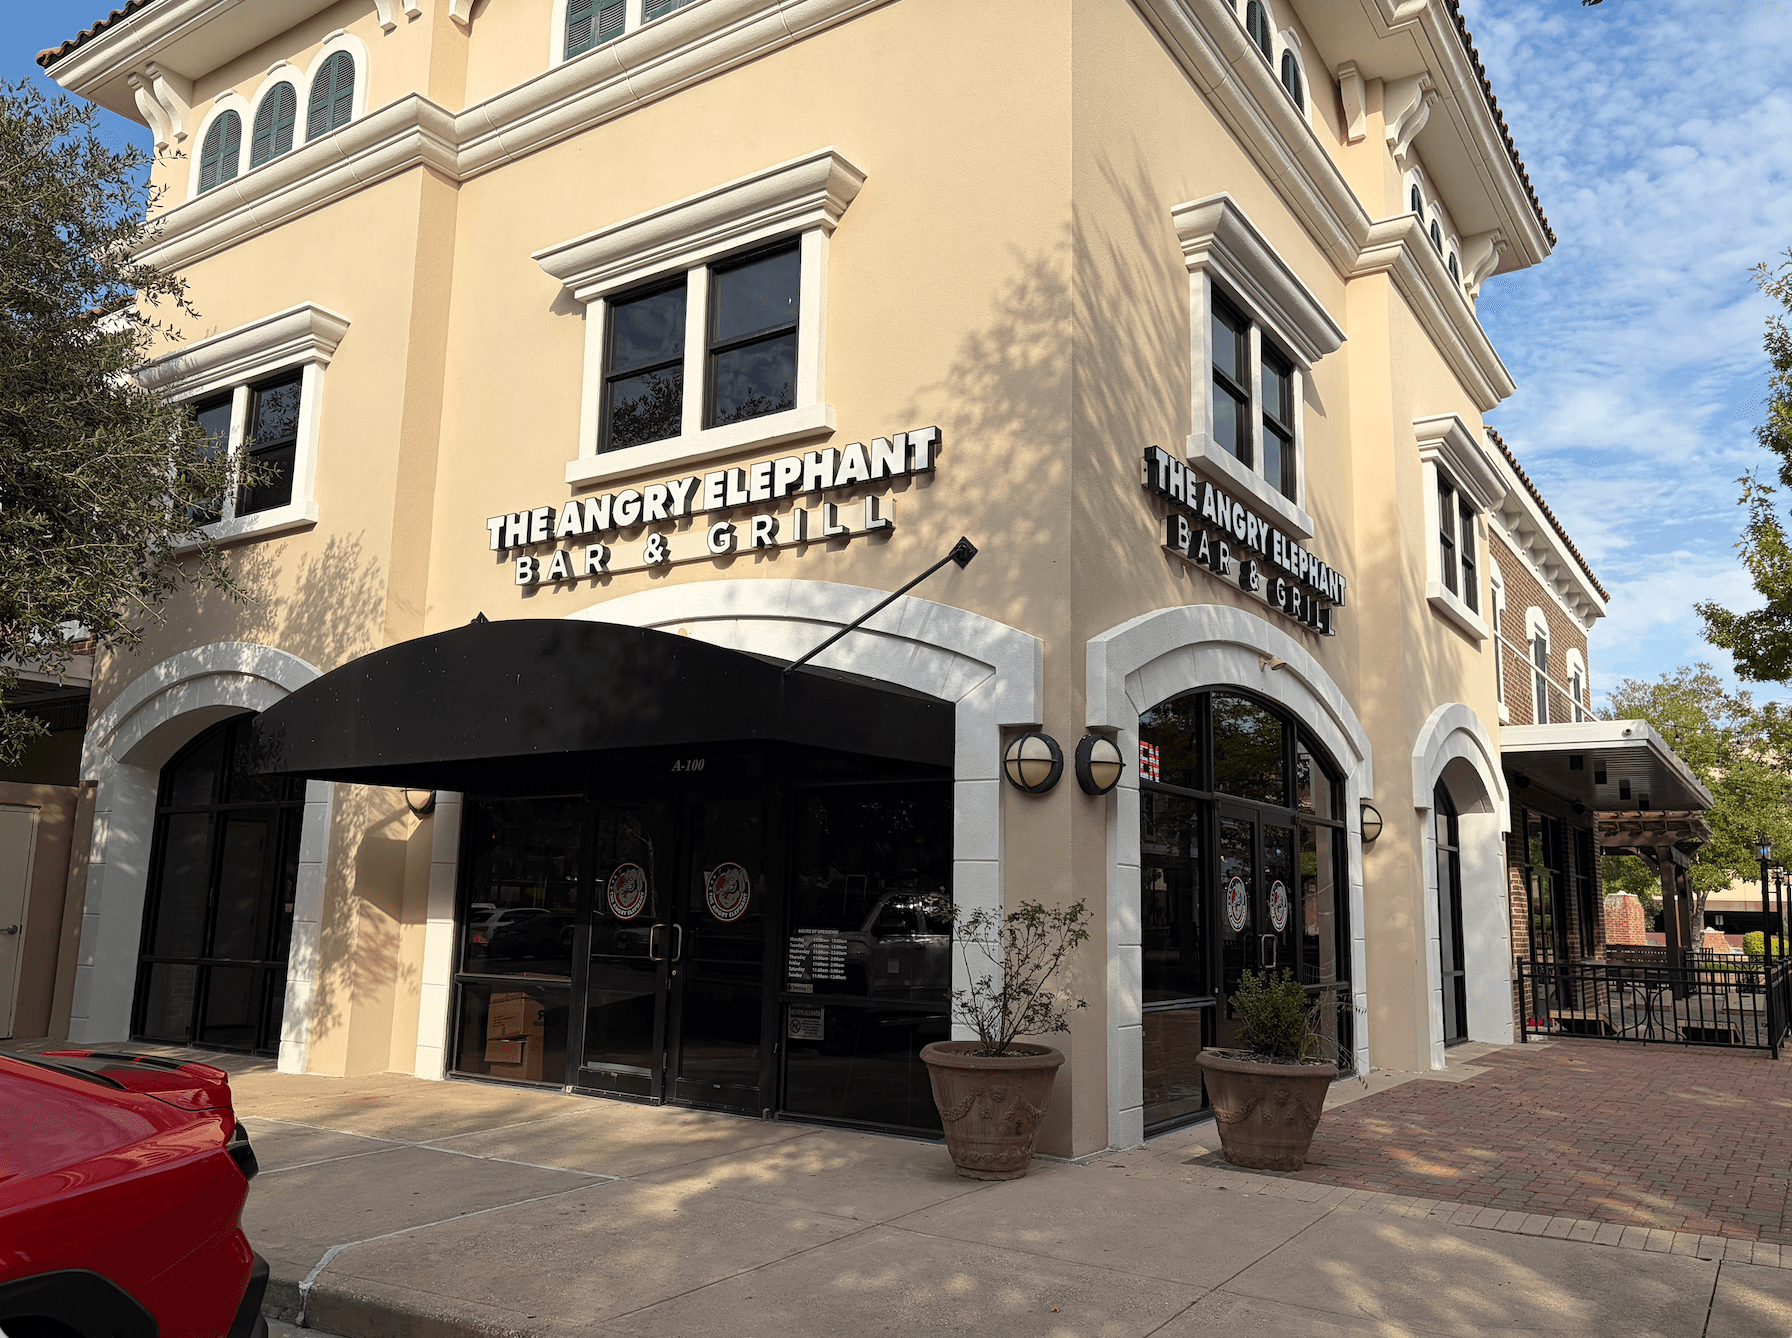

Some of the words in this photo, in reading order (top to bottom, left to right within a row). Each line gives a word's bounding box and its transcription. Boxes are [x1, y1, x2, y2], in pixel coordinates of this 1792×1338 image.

[487, 507, 556, 550] THE
[556, 476, 702, 539] ANGRY
[703, 426, 941, 511] ELEPHANT
[1151, 446, 1198, 511] THE
[1201, 481, 1269, 556] ANGRY
[1272, 527, 1346, 607] ELEPHANT
[515, 543, 612, 586] BAR
[643, 533, 671, 567] &
[707, 495, 893, 554] GRILL
[1173, 514, 1231, 576] BAR
[1273, 577, 1335, 637] GRILL
[671, 759, 705, 772] A-100
[612, 904, 626, 916] ANGRY
[627, 892, 644, 916] ELEPHANT
[712, 904, 728, 918] ANGRY
[728, 892, 748, 918] ELEPHANT
